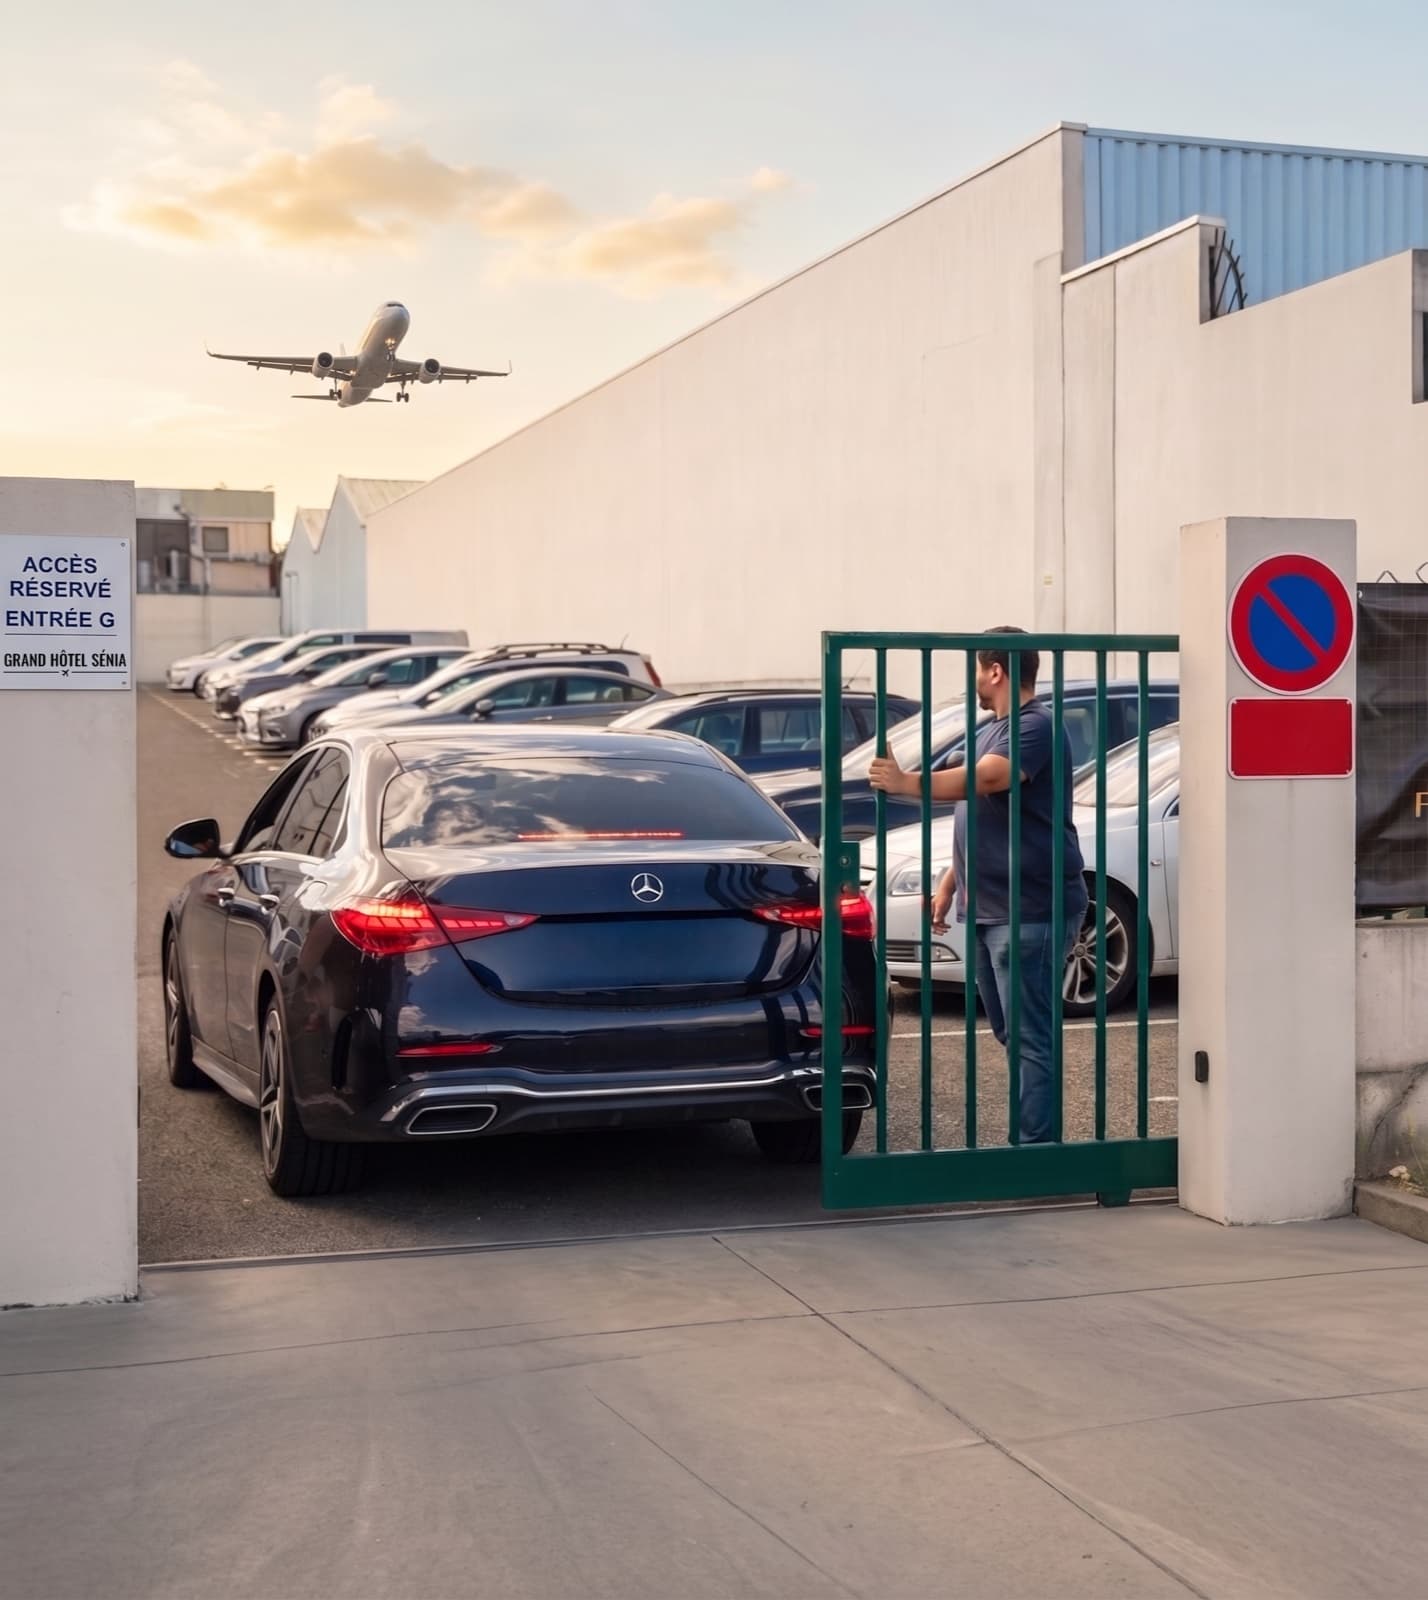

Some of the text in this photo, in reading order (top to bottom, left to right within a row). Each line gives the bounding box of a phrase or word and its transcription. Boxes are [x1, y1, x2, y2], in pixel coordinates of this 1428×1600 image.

[22, 553, 98, 574] ACCÈS
[10, 577, 112, 598] RÉSERVÉ
[5, 608, 115, 628] ENTRÉE G
[3, 649, 127, 667] GRAND HÔTEL SÉNIA
